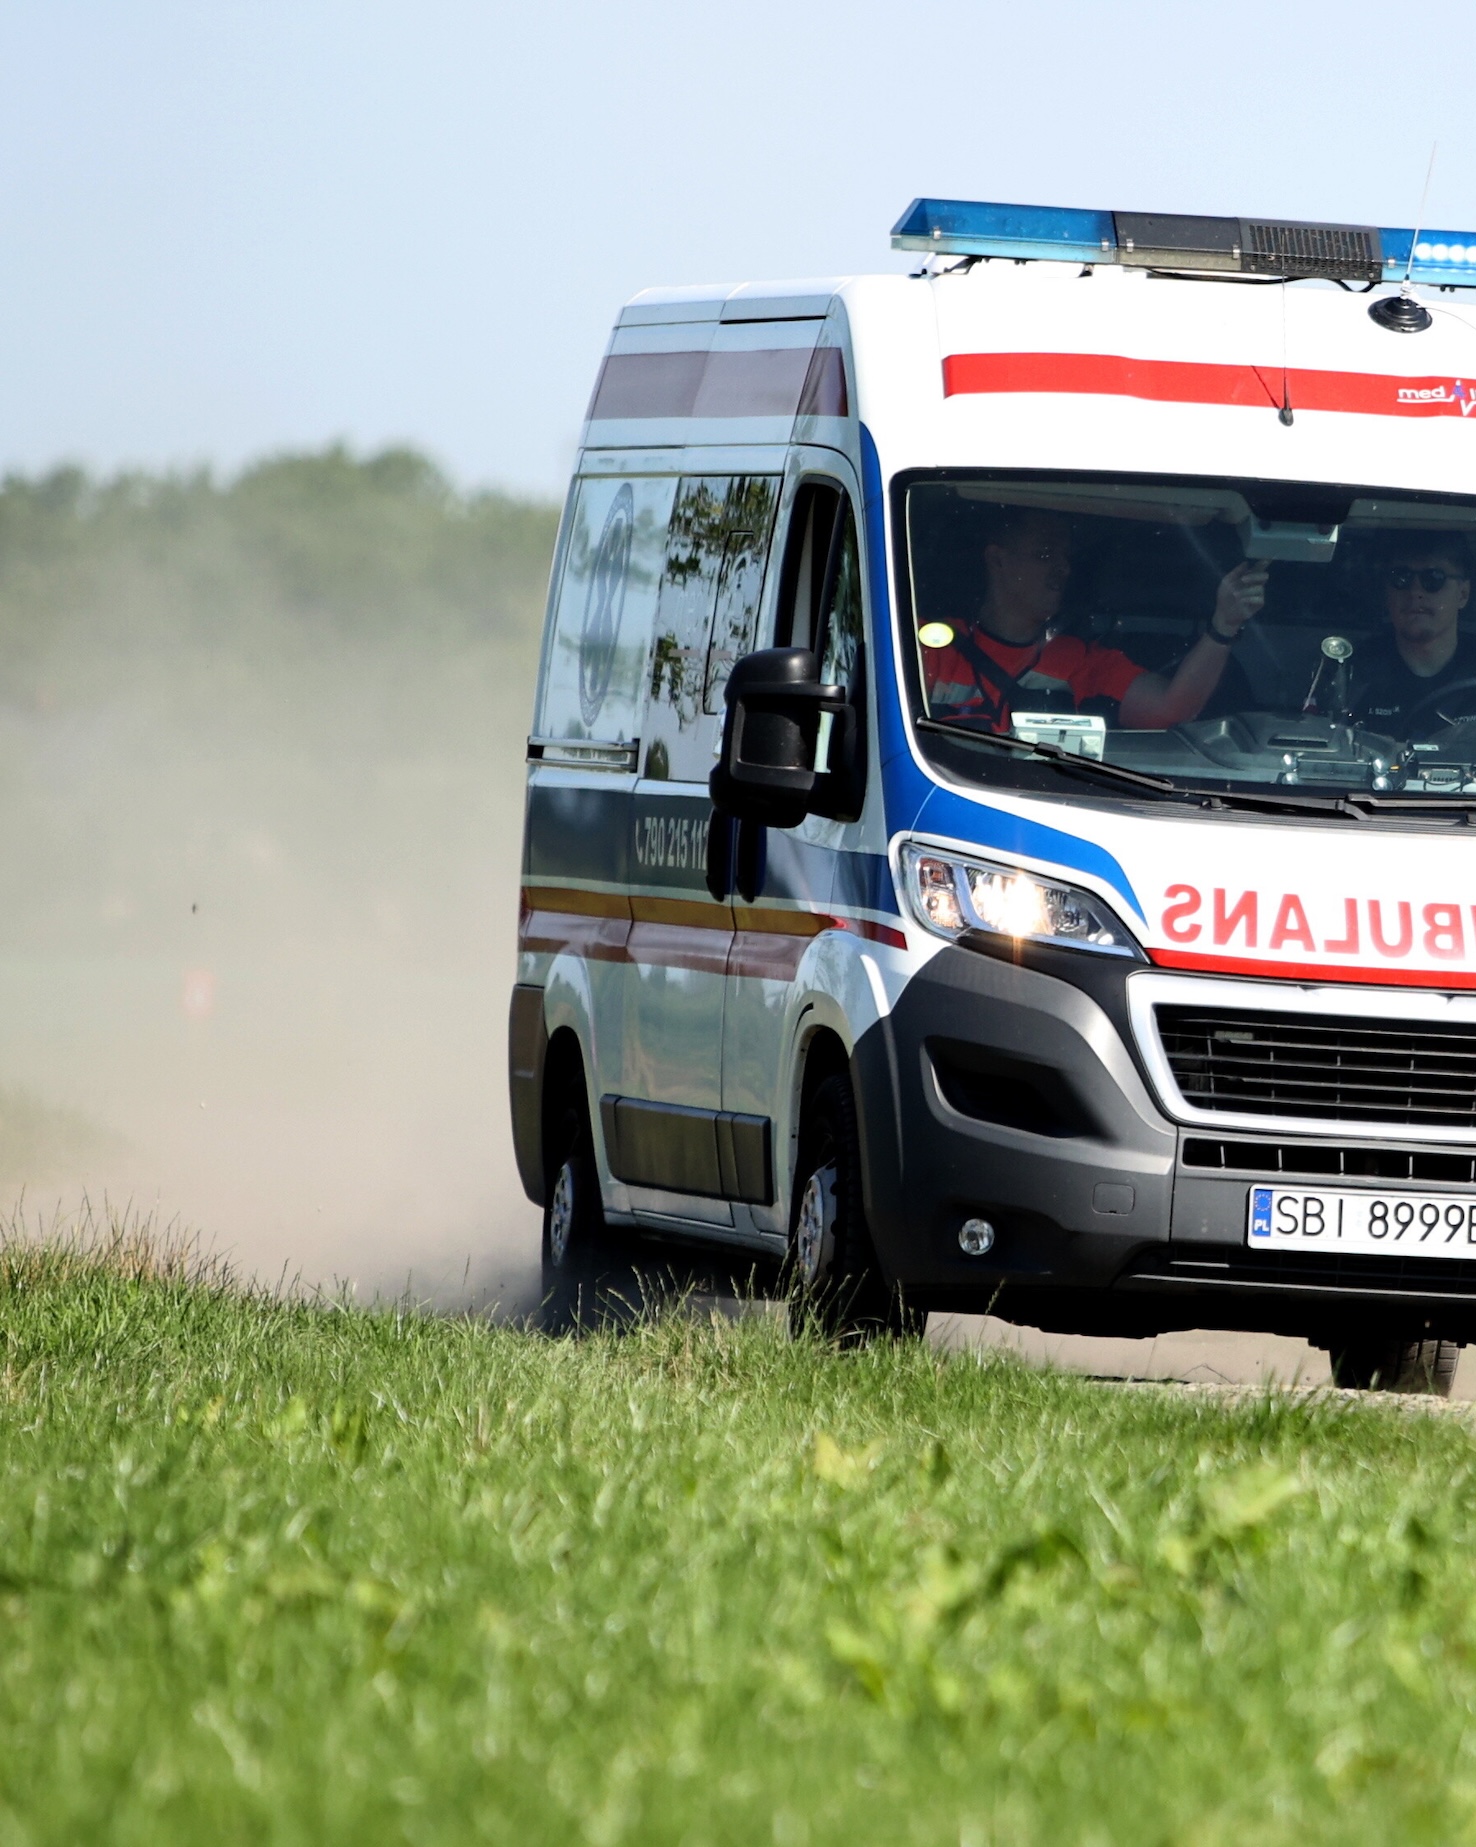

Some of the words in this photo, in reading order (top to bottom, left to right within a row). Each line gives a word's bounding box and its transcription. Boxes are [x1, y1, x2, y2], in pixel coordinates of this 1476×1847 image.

[1397, 385, 1446, 399] med
[644, 816, 665, 867] 790
[667, 817, 689, 869] 215
[1253, 1219, 1270, 1233] PL
[1276, 1195, 1344, 1239] SBI
